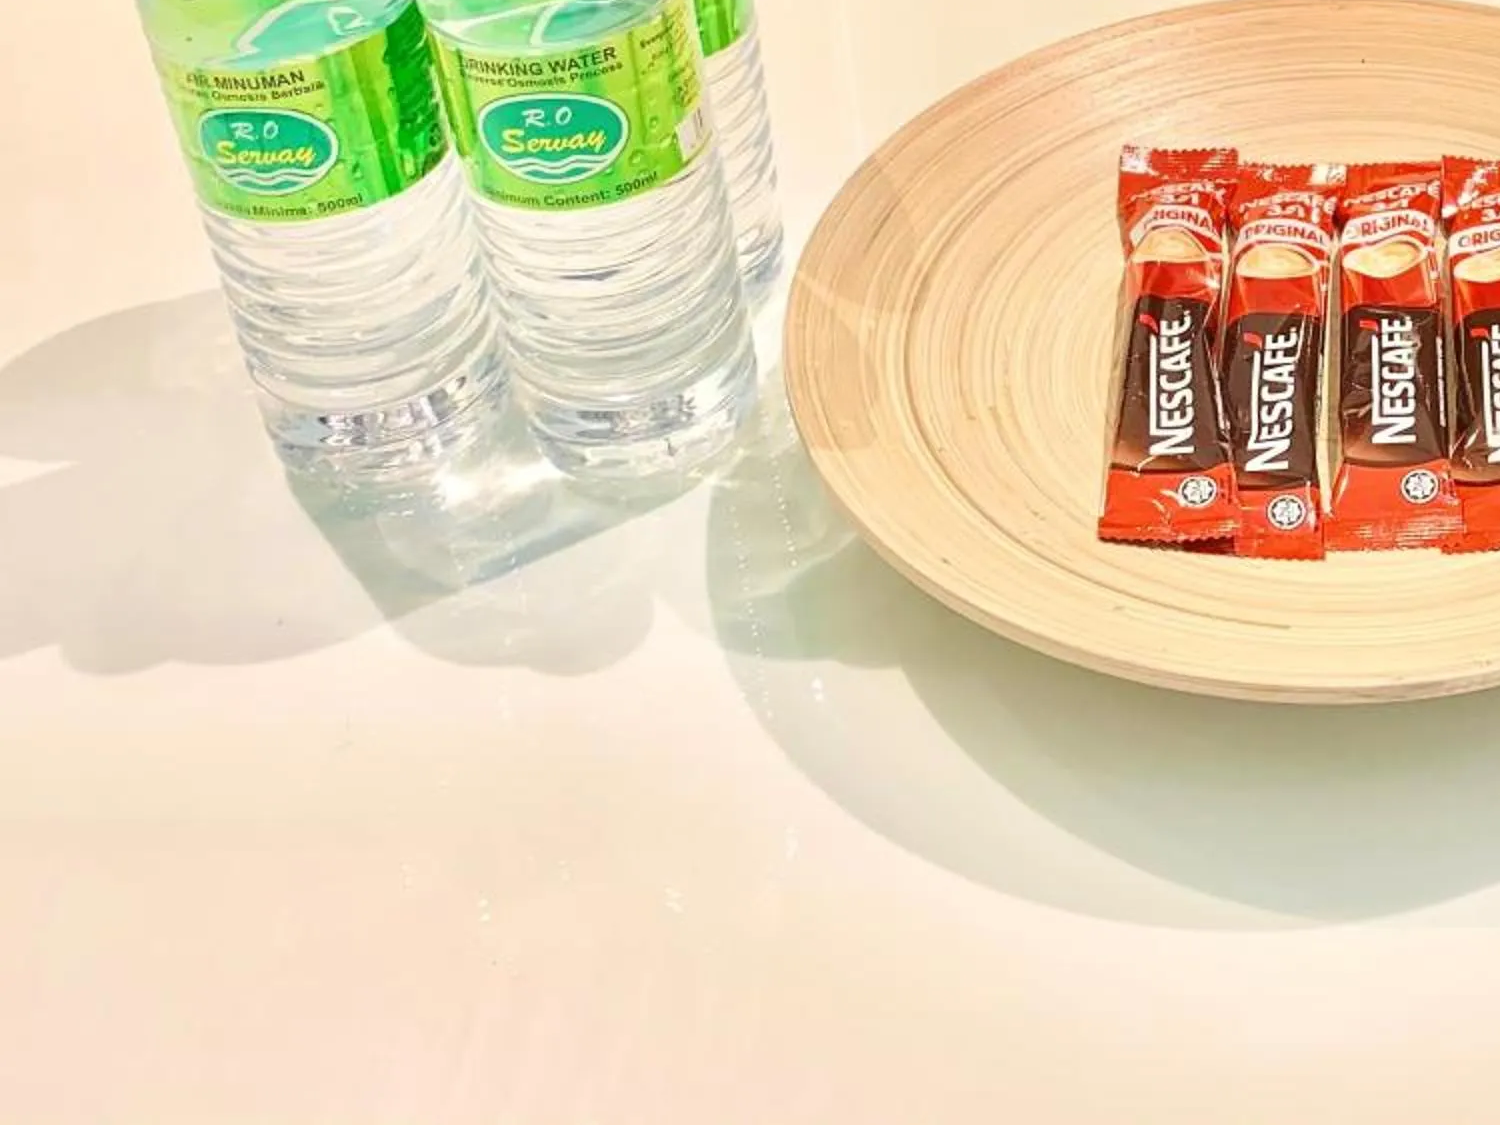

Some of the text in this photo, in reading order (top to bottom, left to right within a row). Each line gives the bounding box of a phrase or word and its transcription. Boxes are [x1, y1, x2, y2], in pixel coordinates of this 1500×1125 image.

[549, 46, 618, 74] WATER
[213, 69, 305, 91] MINUMAN
[502, 128, 607, 154] Servay
[216, 140, 315, 168] Servay
[616, 171, 658, 196] 500ml
[317, 193, 364, 214] 500ml
